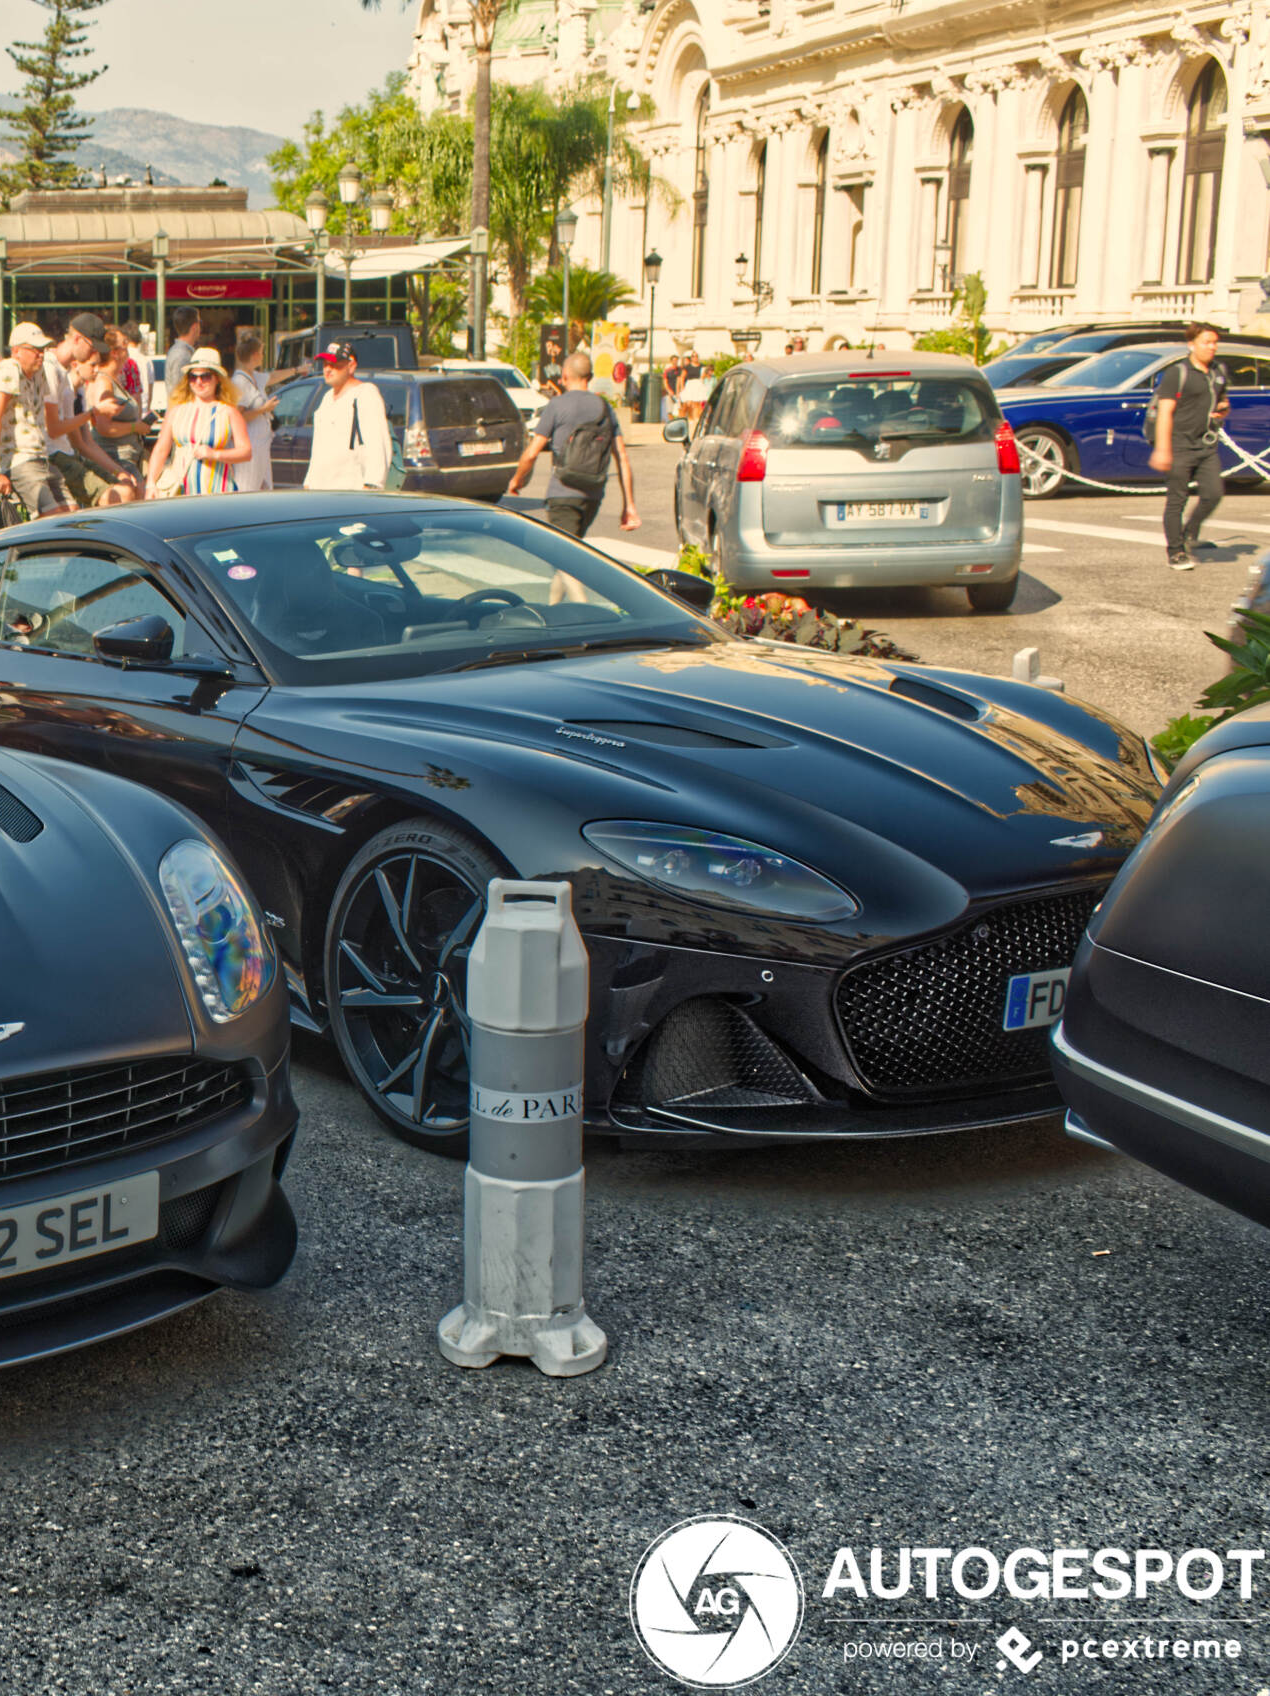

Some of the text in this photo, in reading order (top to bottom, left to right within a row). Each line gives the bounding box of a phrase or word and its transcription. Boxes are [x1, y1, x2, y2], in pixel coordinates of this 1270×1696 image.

[1029, 979, 1066, 1020] FD
[490, 1099, 514, 1118] de
[35, 1193, 129, 1260] SEL
